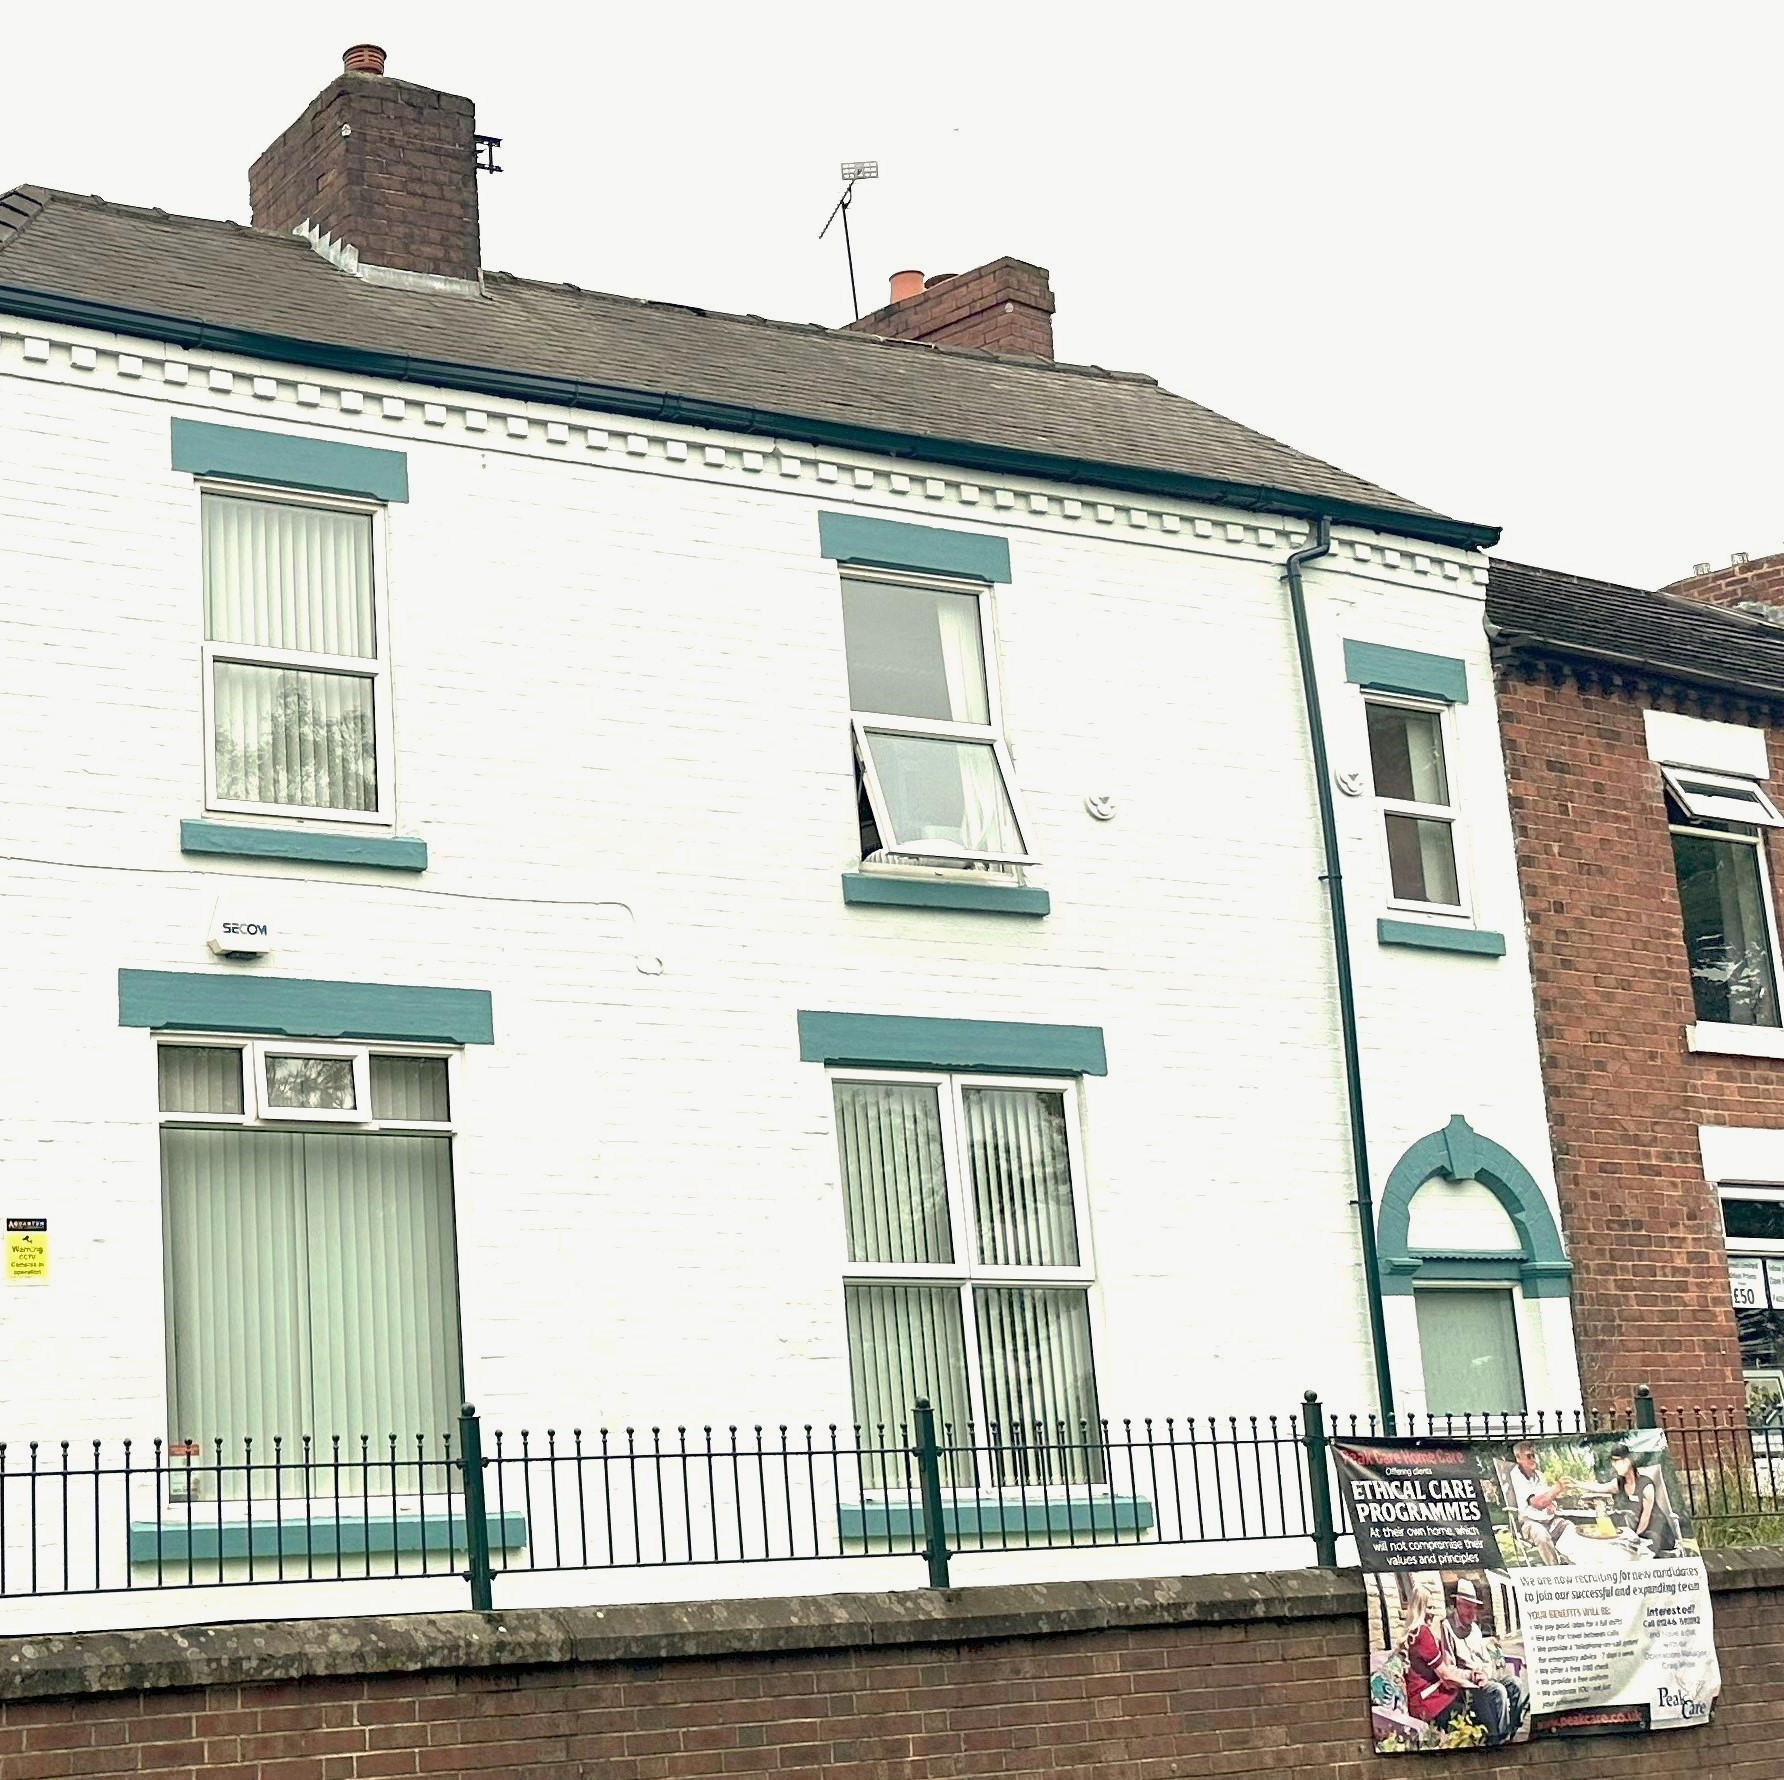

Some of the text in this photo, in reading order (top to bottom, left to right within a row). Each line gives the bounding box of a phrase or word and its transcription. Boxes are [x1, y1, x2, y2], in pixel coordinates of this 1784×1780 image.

[222, 922, 267, 936] SECOM
[12, 1246, 43, 1254] Warning
[1734, 1288, 1754, 1304] £50
[1342, 1449, 1464, 1464] Peak Care Home Care
[1386, 1468, 1412, 1476] Offering
[1351, 1480, 1476, 1500] ETHICAL CARE
[1356, 1502, 1482, 1522] PROGRAMMES
[1370, 1527, 1380, 1538] At
[1383, 1526, 1404, 1537] their
[1407, 1528, 1426, 1536] own
[1455, 1526, 1480, 1536] which
[1373, 1538, 1484, 1554] will not compromise their
[1386, 1552, 1479, 1566] values and principles
[1520, 1566, 1698, 1586] We are now recruiting for new candidates
[1524, 1582, 1700, 1604] to join our successful and expanding team
[1527, 1610, 1548, 1620] YOUR
[1582, 1607, 1600, 1616] WILL
[1647, 1604, 1695, 1616] Interested?
[1643, 1620, 1655, 1628] Call
[1658, 1688, 1686, 1708] Peak
[1682, 1700, 1706, 1719] Care
[1537, 1710, 1642, 1729] www.peakcare.co.uk
